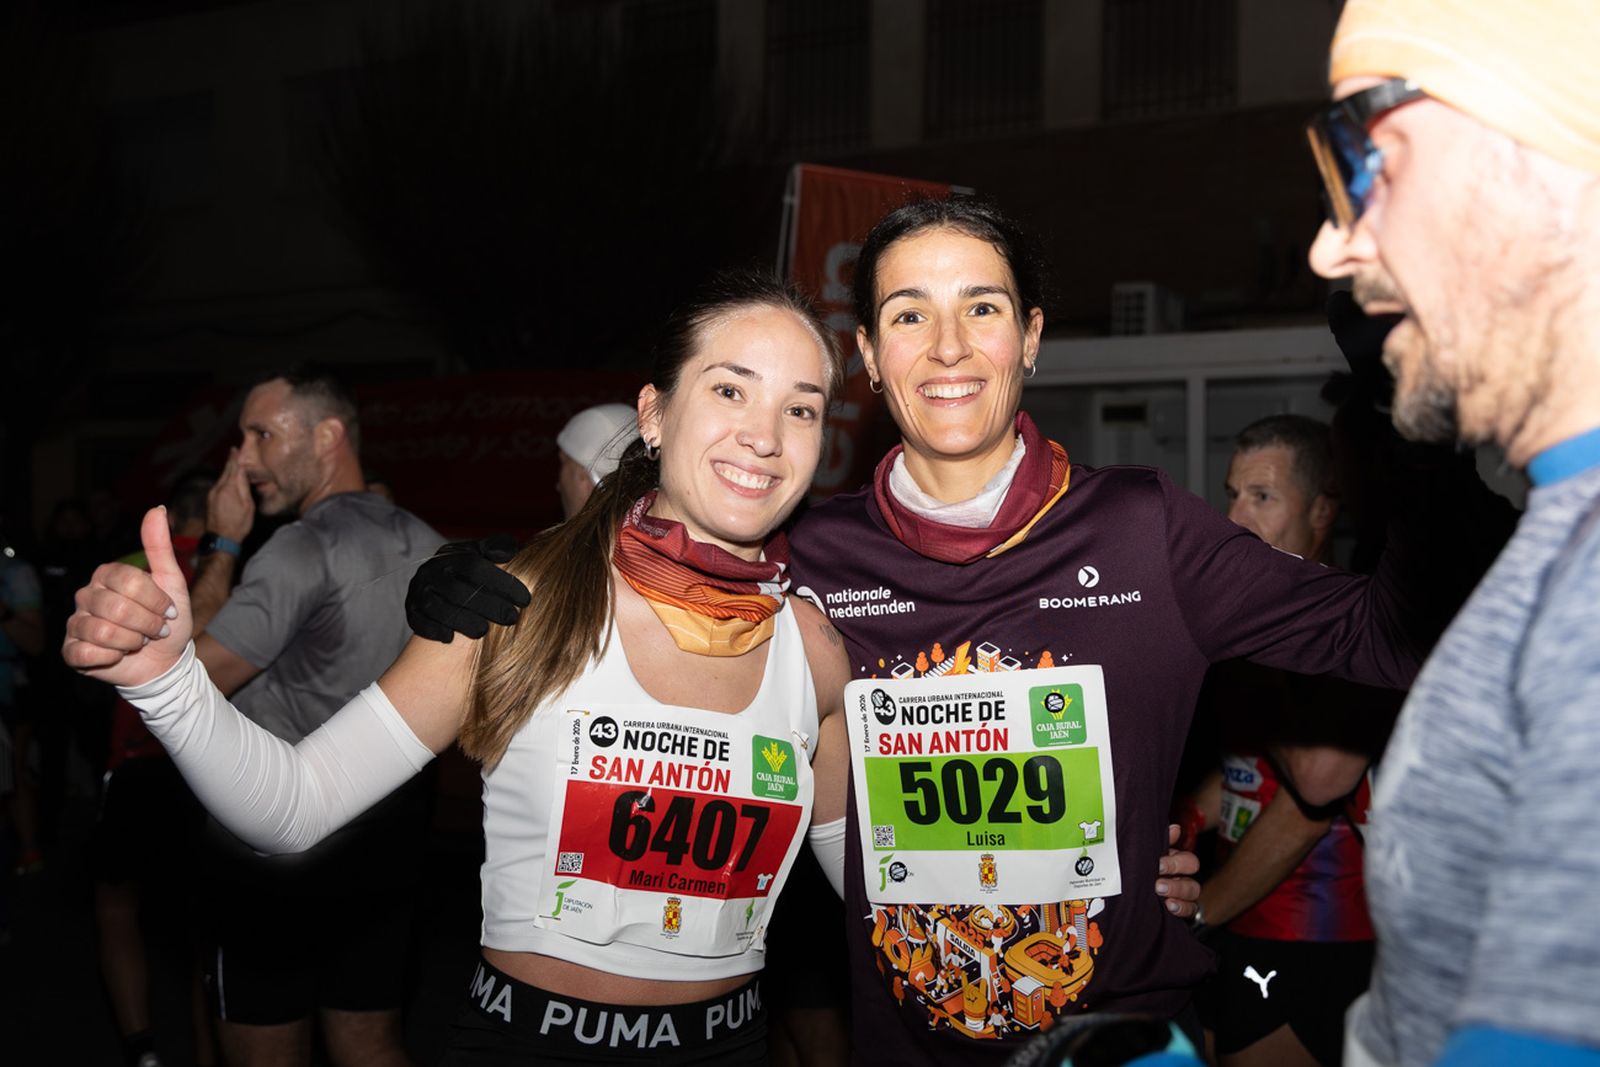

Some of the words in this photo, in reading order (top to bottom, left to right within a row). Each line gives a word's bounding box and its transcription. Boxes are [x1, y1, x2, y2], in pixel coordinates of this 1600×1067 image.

[826, 587, 891, 605] nationale
[1038, 590, 1142, 609] BOOMERANG
[829, 600, 916, 619] nederlanden
[898, 696, 927, 704] CARRERA
[927, 693, 954, 703] URBANA
[953, 690, 1004, 701] INTERNACIONAL
[901, 702, 973, 726] NOCHE
[978, 700, 1006, 722] DE
[590, 722, 617, 739] 43
[623, 720, 656, 729] CARRERA
[656, 722, 682, 732] URBANA
[682, 725, 730, 739] INTERNACIONAL
[878, 732, 923, 755] SAN
[928, 722, 1009, 755] ANTÓN
[1036, 722, 1055, 733] CAJA
[623, 729, 699, 757] NOCHE
[703, 739, 730, 761] DE
[589, 755, 644, 783] SAN
[648, 761, 731, 793] ANTÓN
[899, 755, 1066, 825] 5029
[608, 790, 771, 873] 6407
[966, 831, 1006, 847] Luisa
[628, 869, 664, 888] Mari
[667, 872, 726, 894] Carmen
[539, 1000, 681, 1049] PUMA
